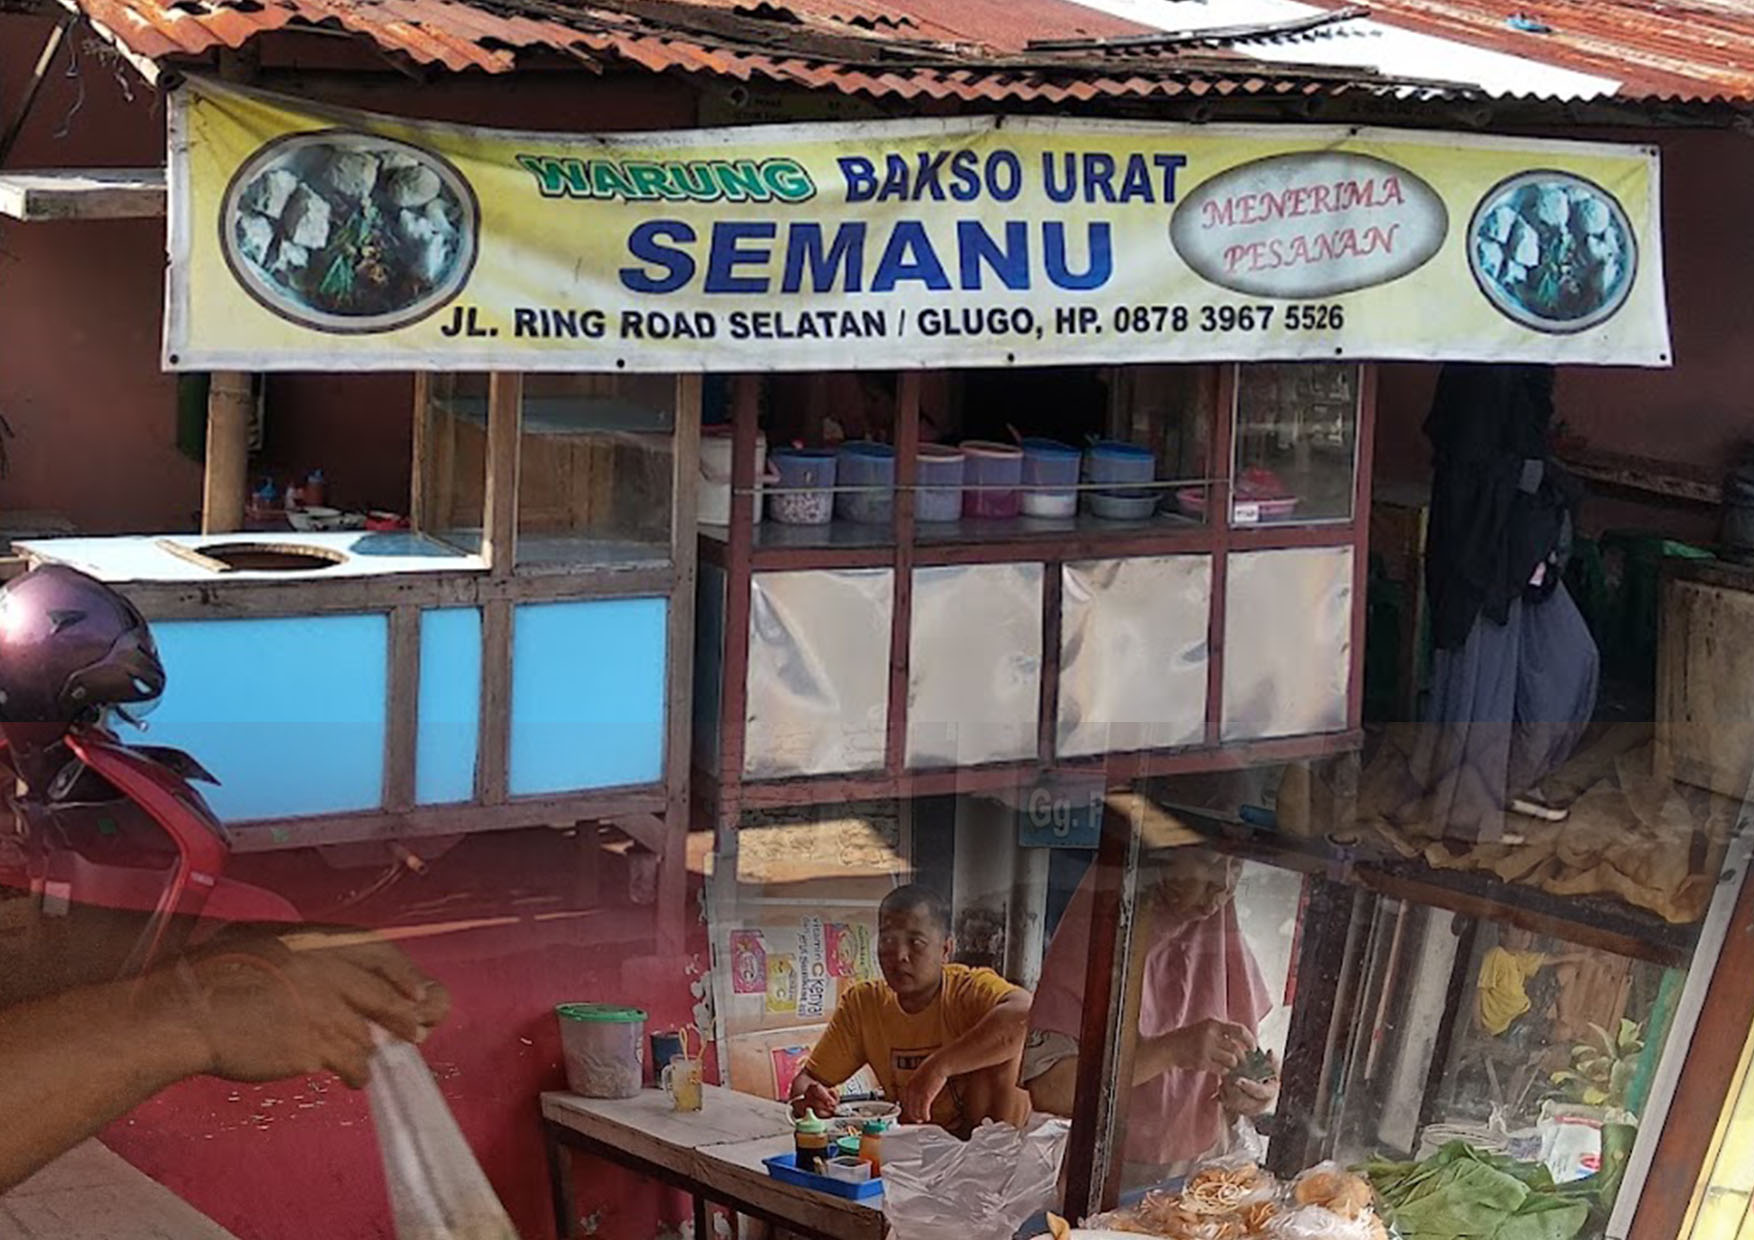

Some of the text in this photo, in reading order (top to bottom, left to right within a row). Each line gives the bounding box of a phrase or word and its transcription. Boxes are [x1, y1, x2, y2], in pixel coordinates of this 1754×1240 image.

[515, 149, 1187, 204] WARUNG BAKSO URAT
[1201, 174, 1406, 231] MENERIMA
[619, 218, 1115, 295] SEMANU
[1223, 224, 1402, 276] PESANAN
[440, 304, 1344, 340] JL. RING ROAD SELATAN / GLUGO, HP. 0878 3967 5526
